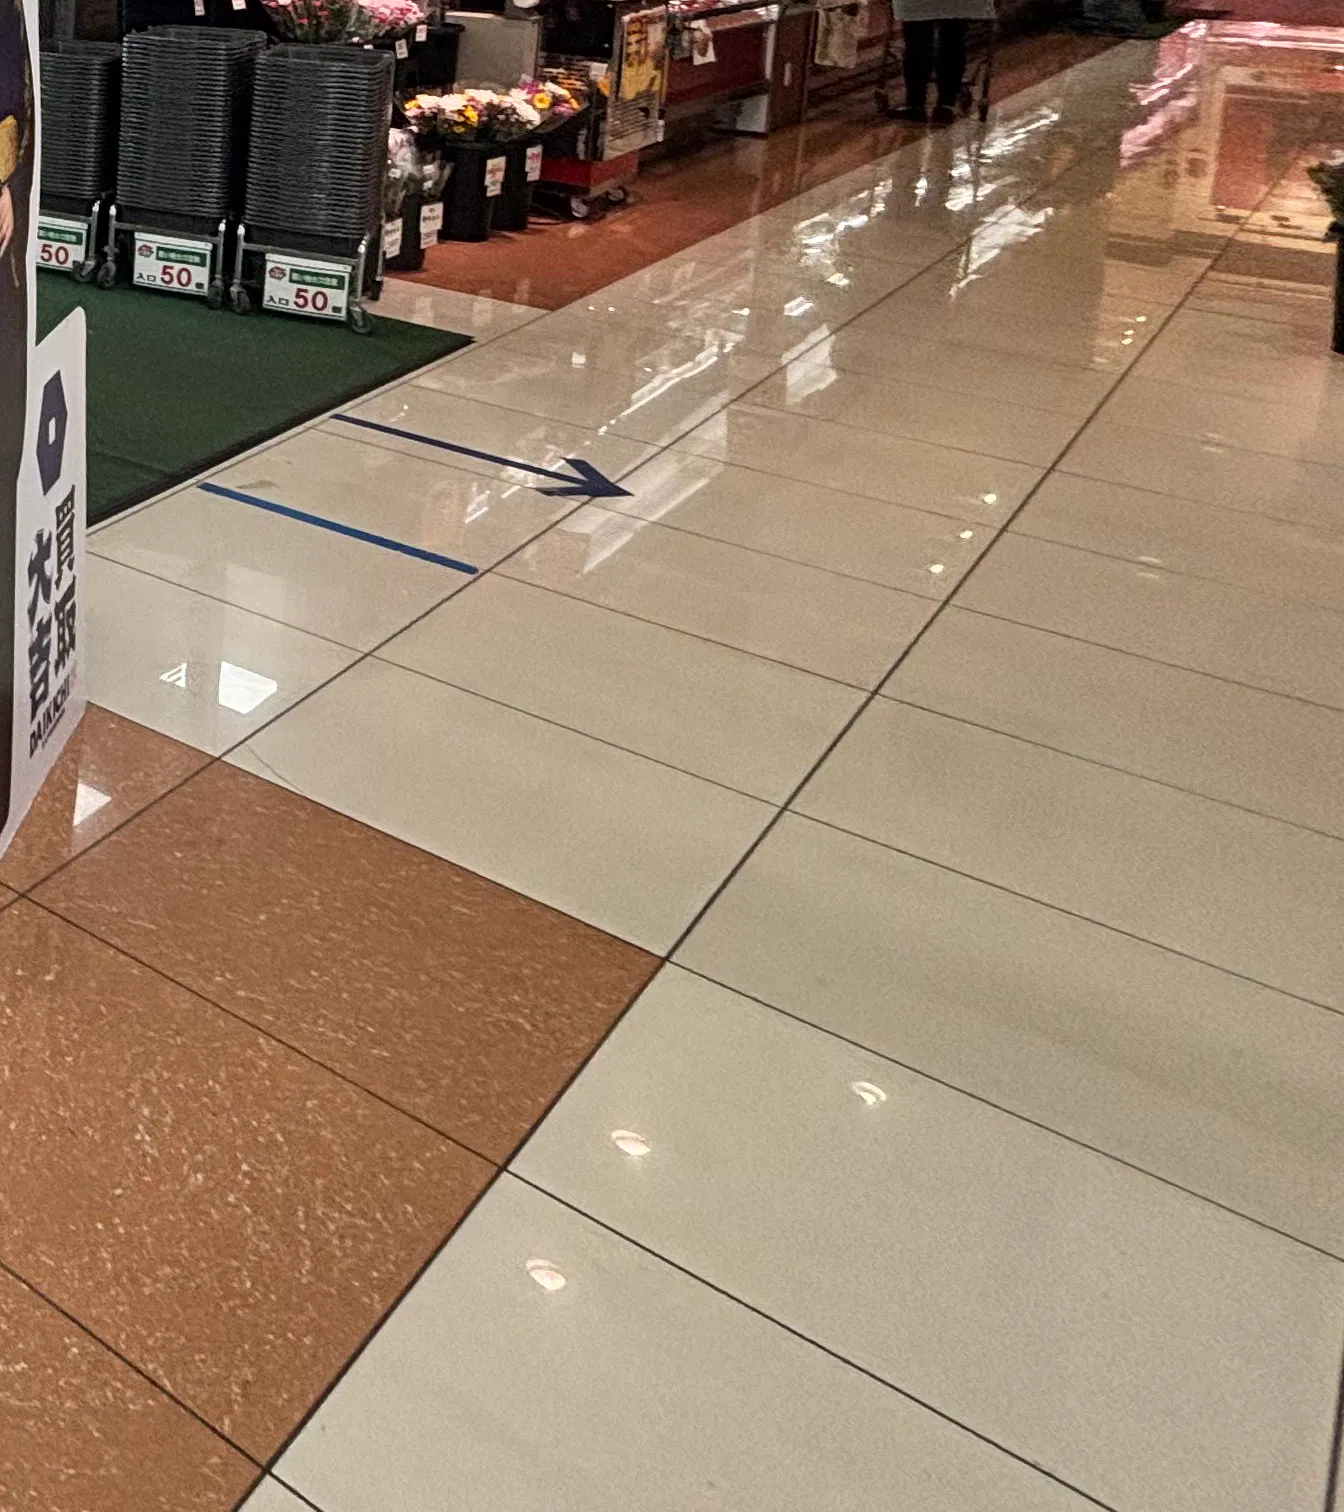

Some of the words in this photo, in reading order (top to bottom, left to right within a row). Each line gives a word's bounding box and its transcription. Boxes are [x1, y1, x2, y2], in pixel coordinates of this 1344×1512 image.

[40, 244, 70, 266] 50
[160, 264, 192, 288] 50
[293, 288, 328, 312] 50
[54, 483, 77, 679] 買取
[28, 527, 53, 724] 大吉
